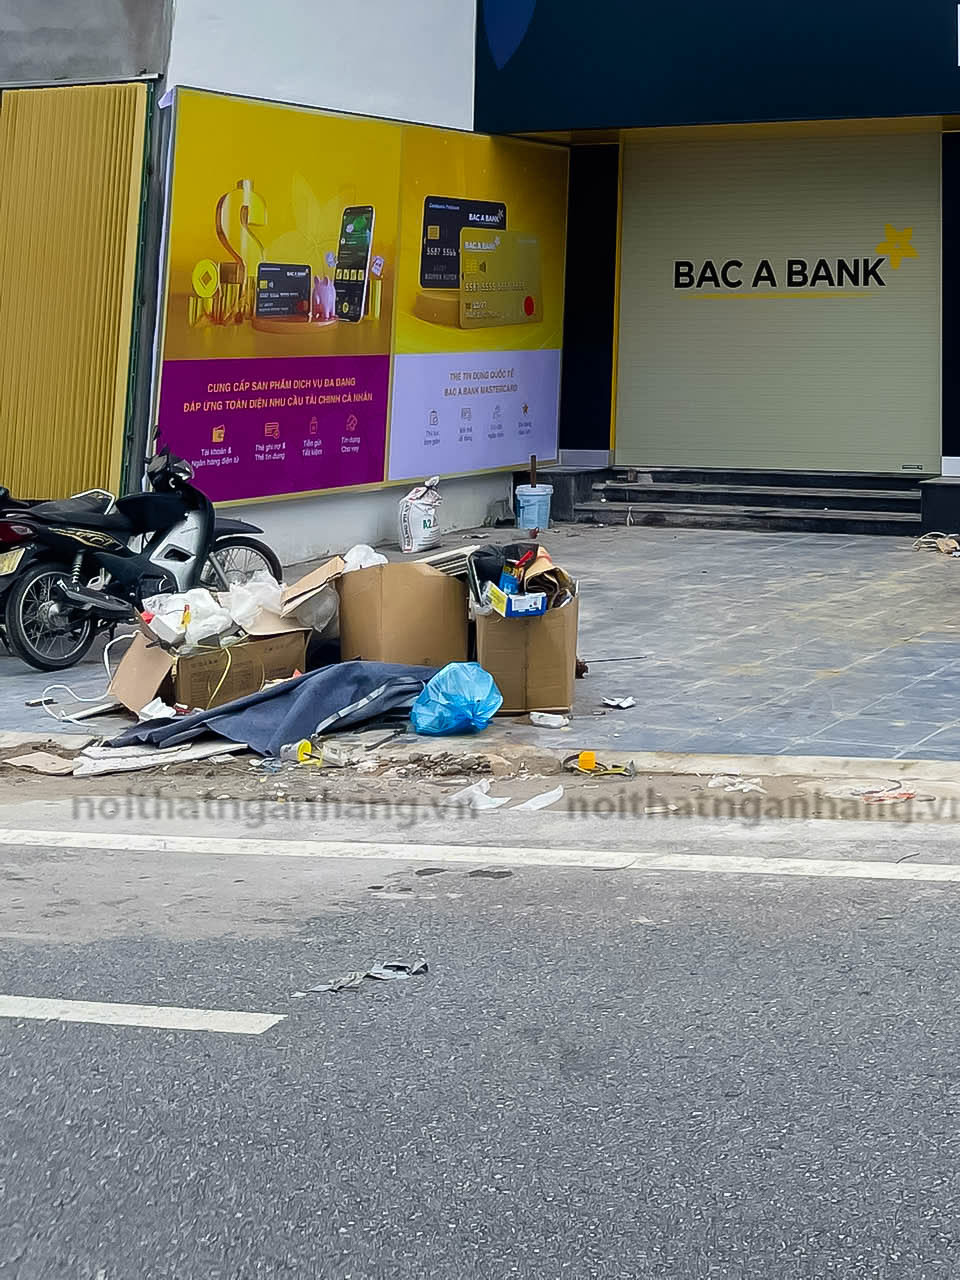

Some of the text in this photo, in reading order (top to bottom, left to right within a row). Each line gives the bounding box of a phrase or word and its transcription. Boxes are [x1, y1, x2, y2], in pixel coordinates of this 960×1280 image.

[674, 257, 886, 289] BAC A BANK
